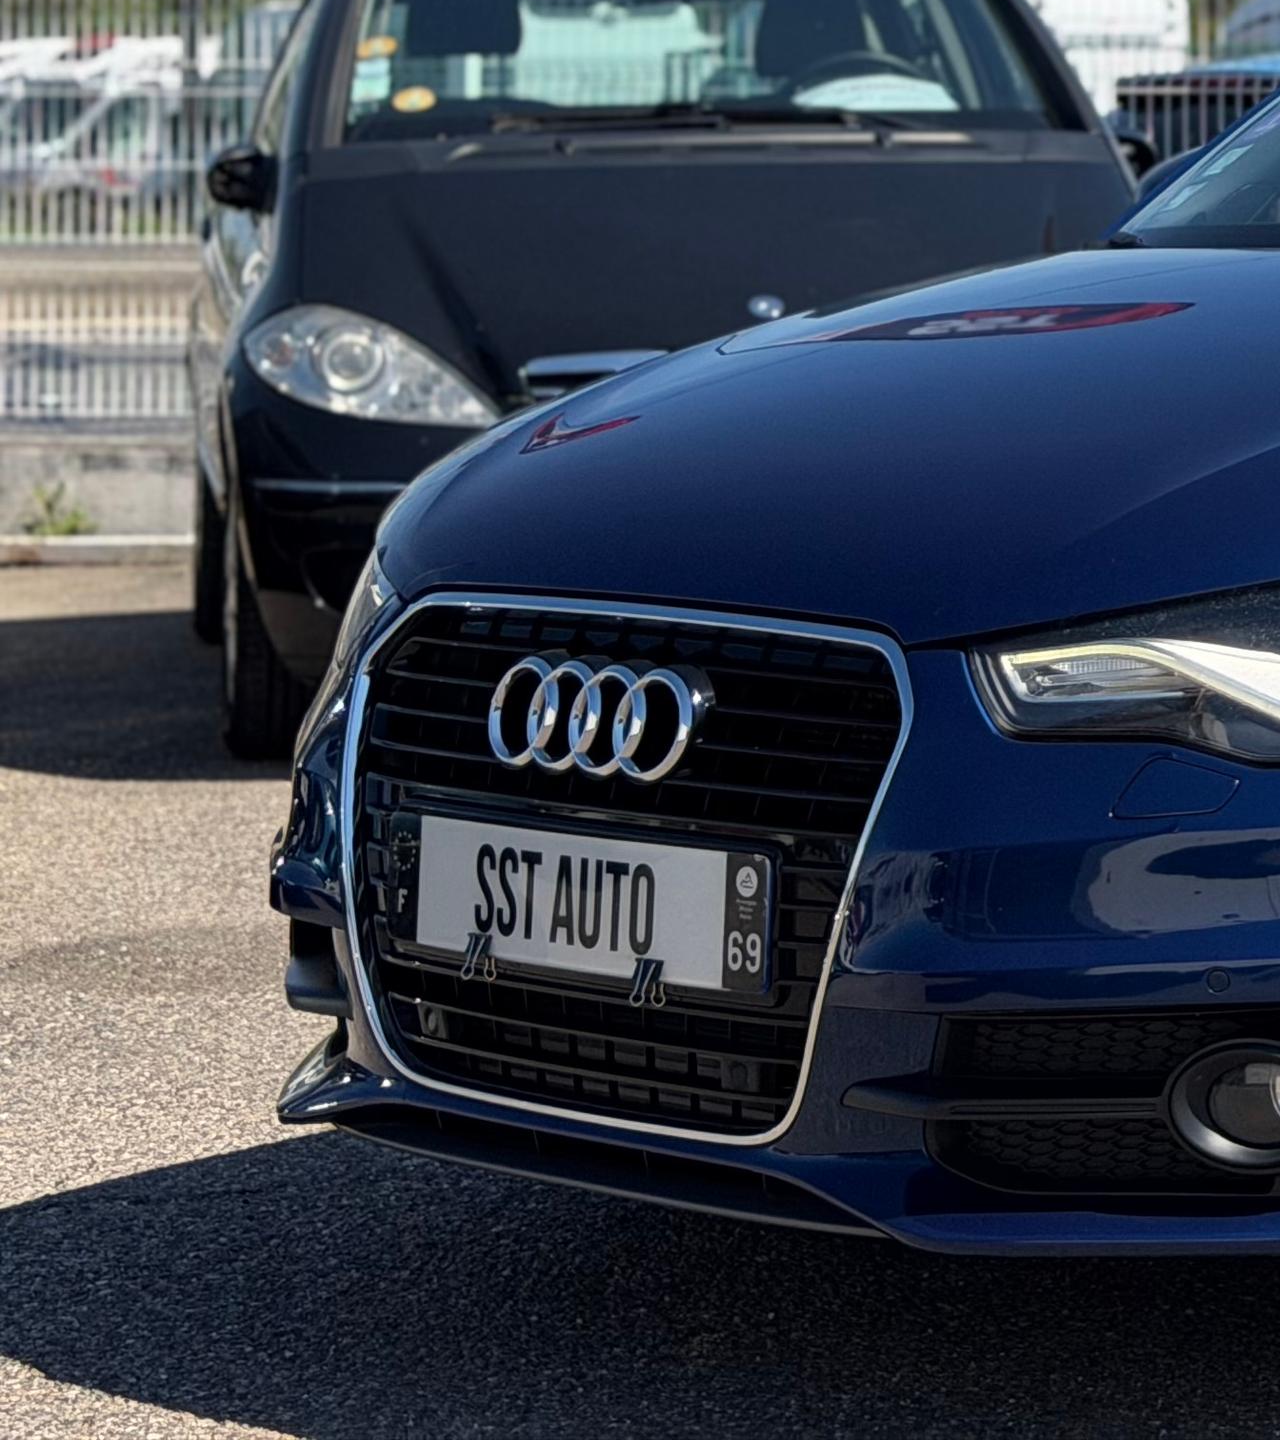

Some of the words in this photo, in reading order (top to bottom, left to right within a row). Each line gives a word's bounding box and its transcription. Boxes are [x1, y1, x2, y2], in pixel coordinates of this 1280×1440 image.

[474, 843, 543, 940] SST
[549, 855, 656, 955] AUTO
[727, 930, 762, 973] 69
